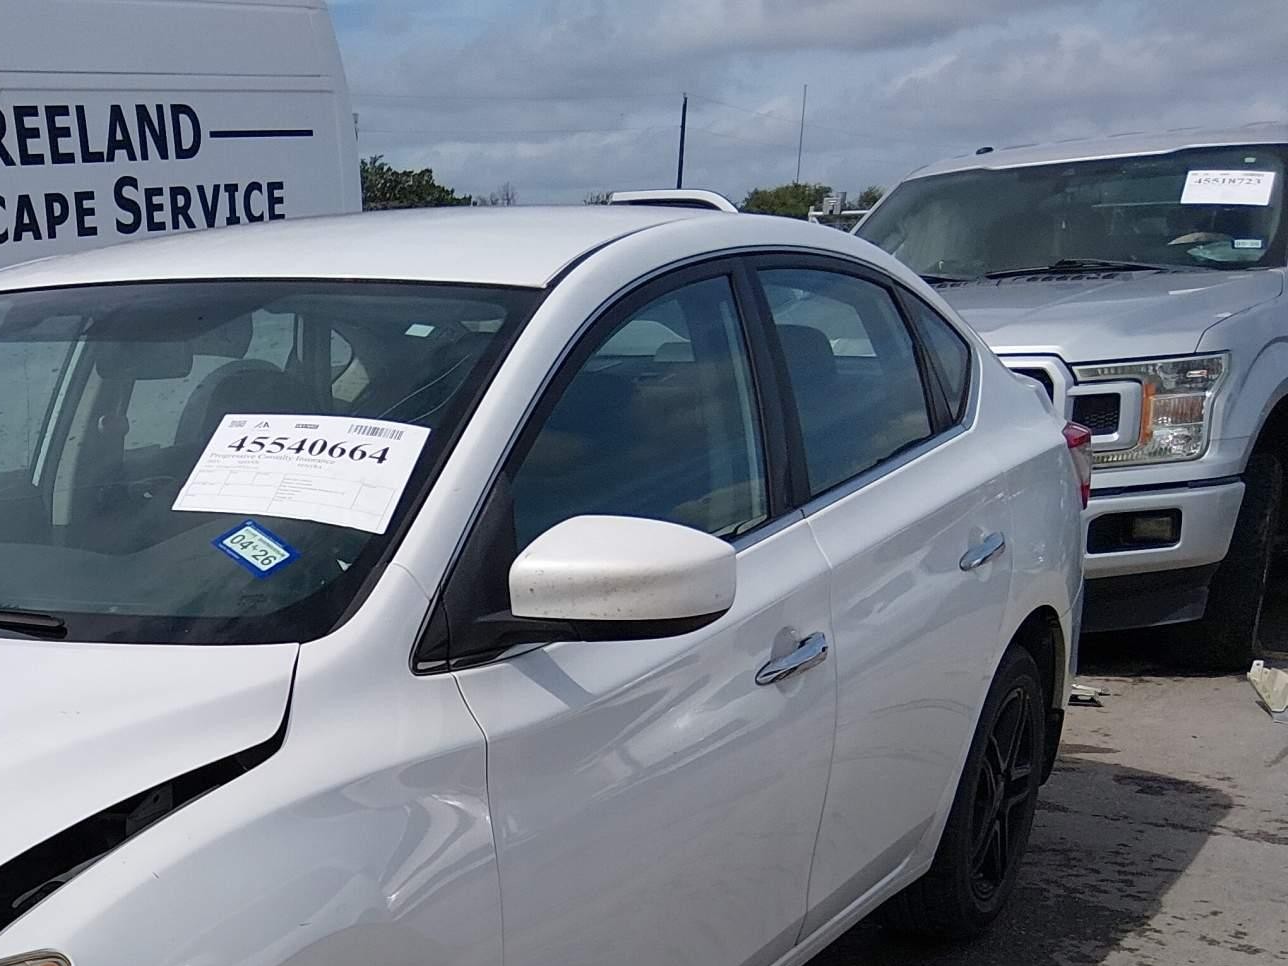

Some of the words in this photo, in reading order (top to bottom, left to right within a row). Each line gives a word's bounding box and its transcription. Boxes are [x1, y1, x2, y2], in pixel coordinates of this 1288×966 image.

[113, 175, 287, 234] SERVICE
[227, 435, 391, 464] 45540664
[230, 534, 254, 551] 04
[251, 549, 277, 566] 26
